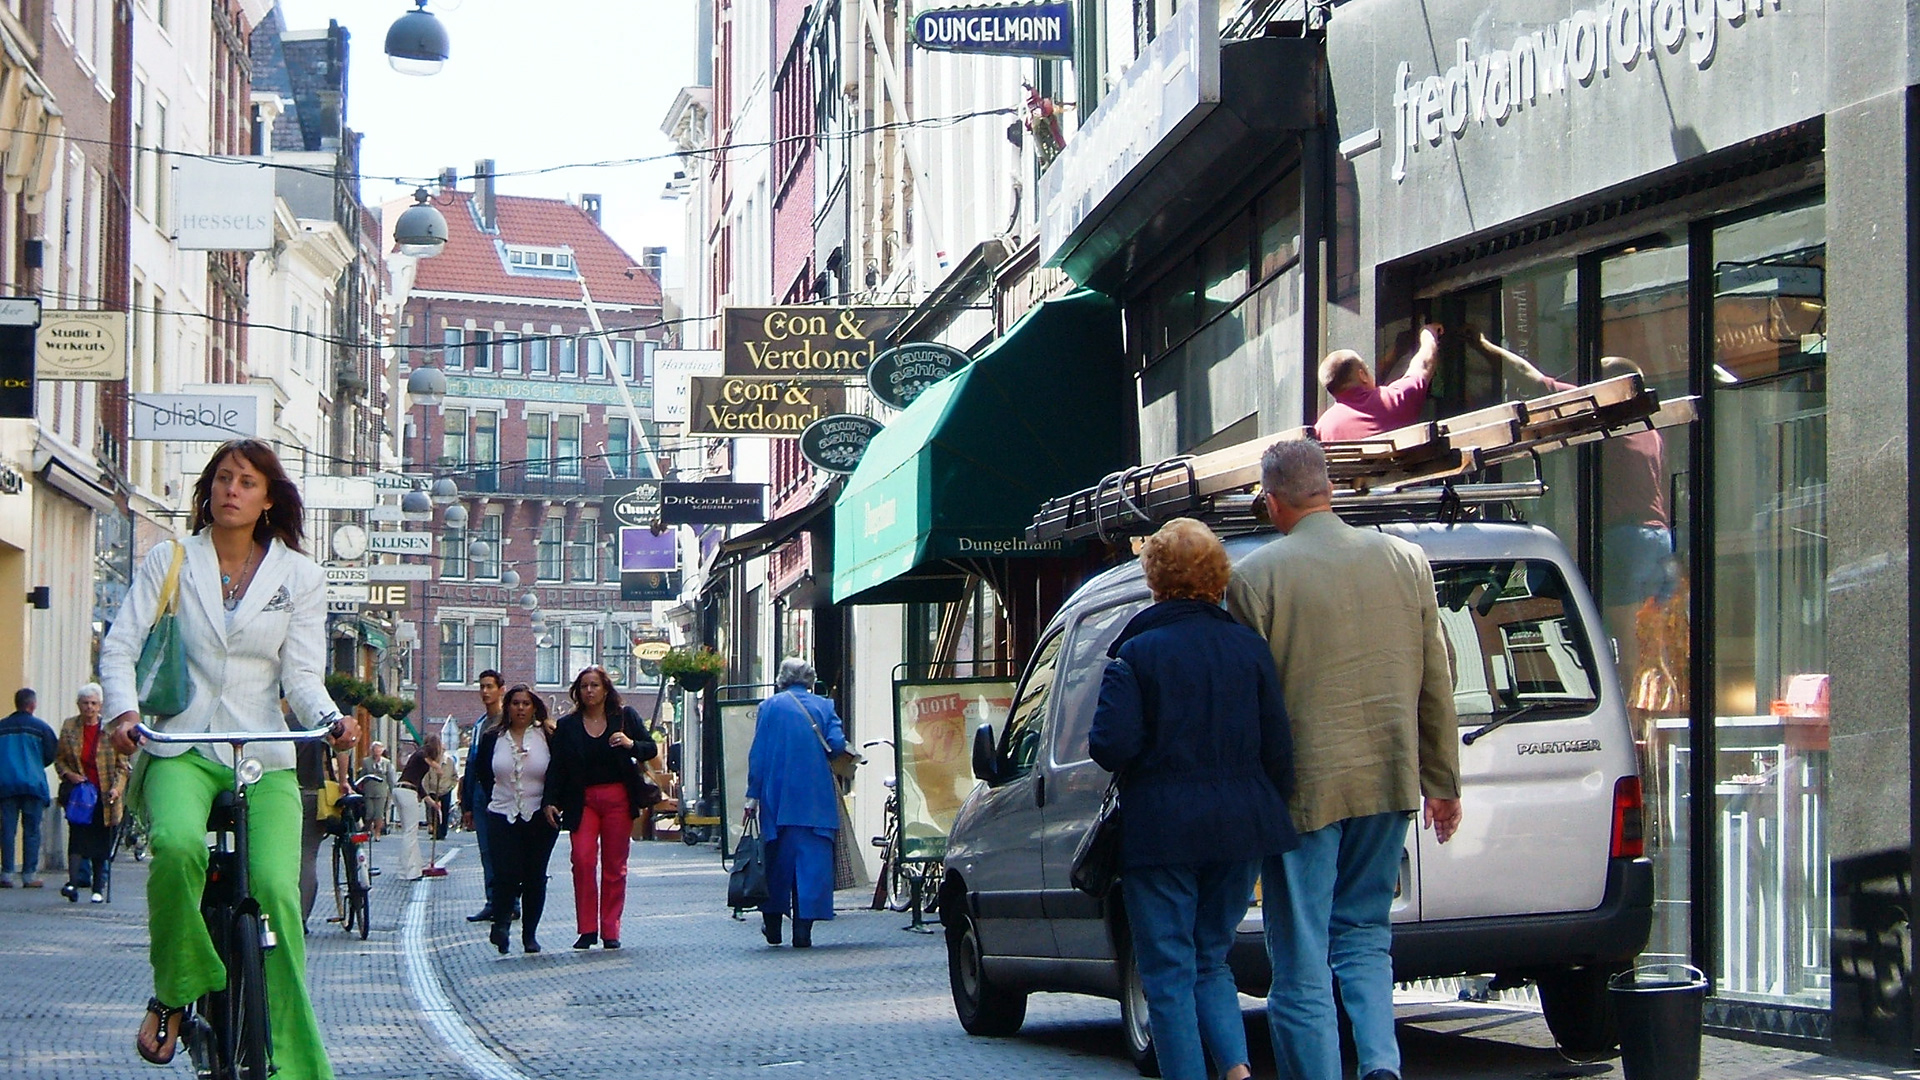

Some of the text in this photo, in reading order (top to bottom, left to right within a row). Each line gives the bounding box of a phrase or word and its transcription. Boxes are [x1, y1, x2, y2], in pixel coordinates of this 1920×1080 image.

[924, 17, 1061, 42] DUNGELMANN
[1391, 0, 1783, 184] fredvanwordrag
[51, 328, 92, 338] Studio
[764, 310, 866, 341] Con &
[45, 341, 105, 351] Workouts
[893, 350, 951, 367] laura
[889, 364, 950, 384] ashle
[450, 381, 561, 398] HOLLANDSCHE
[723, 379, 811, 405] Con &
[153, 402, 239, 431] pliable
[821, 421, 871, 435] laura
[818, 431, 868, 450] ashle
[327, 570, 366, 579] GINES
[1517, 739, 1602, 755] PARTNER
